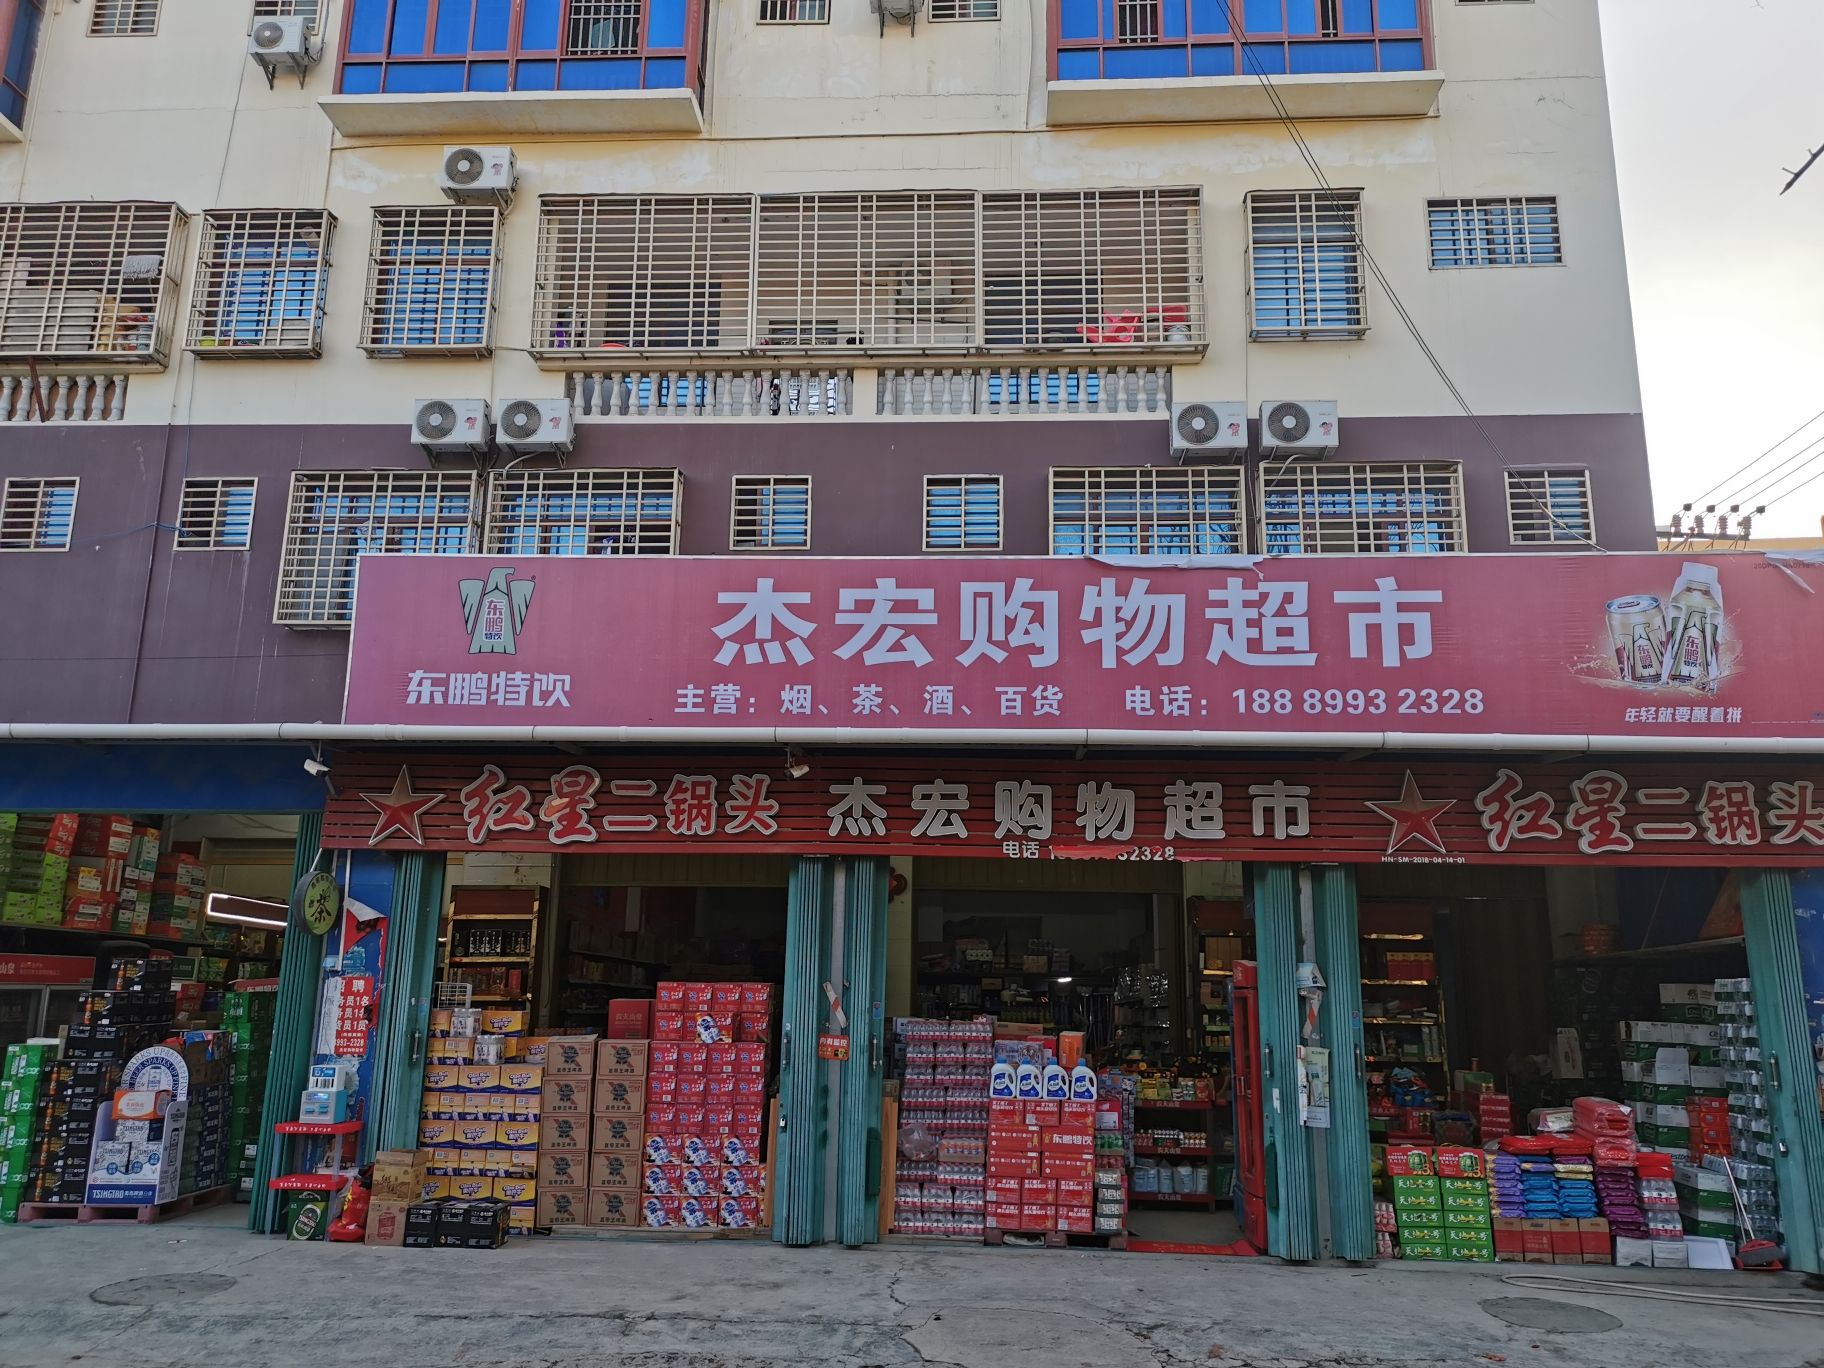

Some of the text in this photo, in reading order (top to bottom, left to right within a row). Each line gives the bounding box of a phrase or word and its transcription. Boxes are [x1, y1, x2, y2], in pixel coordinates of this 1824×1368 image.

[711, 576, 1443, 669] 杰宏购物超市
[406, 670, 572, 707] 东鹏特饮
[1231, 689, 1292, 714] 188
[1302, 688, 1387, 714] 8993
[1397, 688, 1485, 714] 2328
[1624, 706, 1743, 723] 年轻就要醒着拼
[460, 763, 779, 845] 红星二锅头
[826, 776, 1312, 841] 杰宏购物超市
[1475, 768, 1824, 855] 红星二锅头
[1002, 840, 1040, 859] 电话
[1053, 1134, 1093, 1145] 东鹏特饮
[93, 1190, 124, 1198] TSINGTAO
